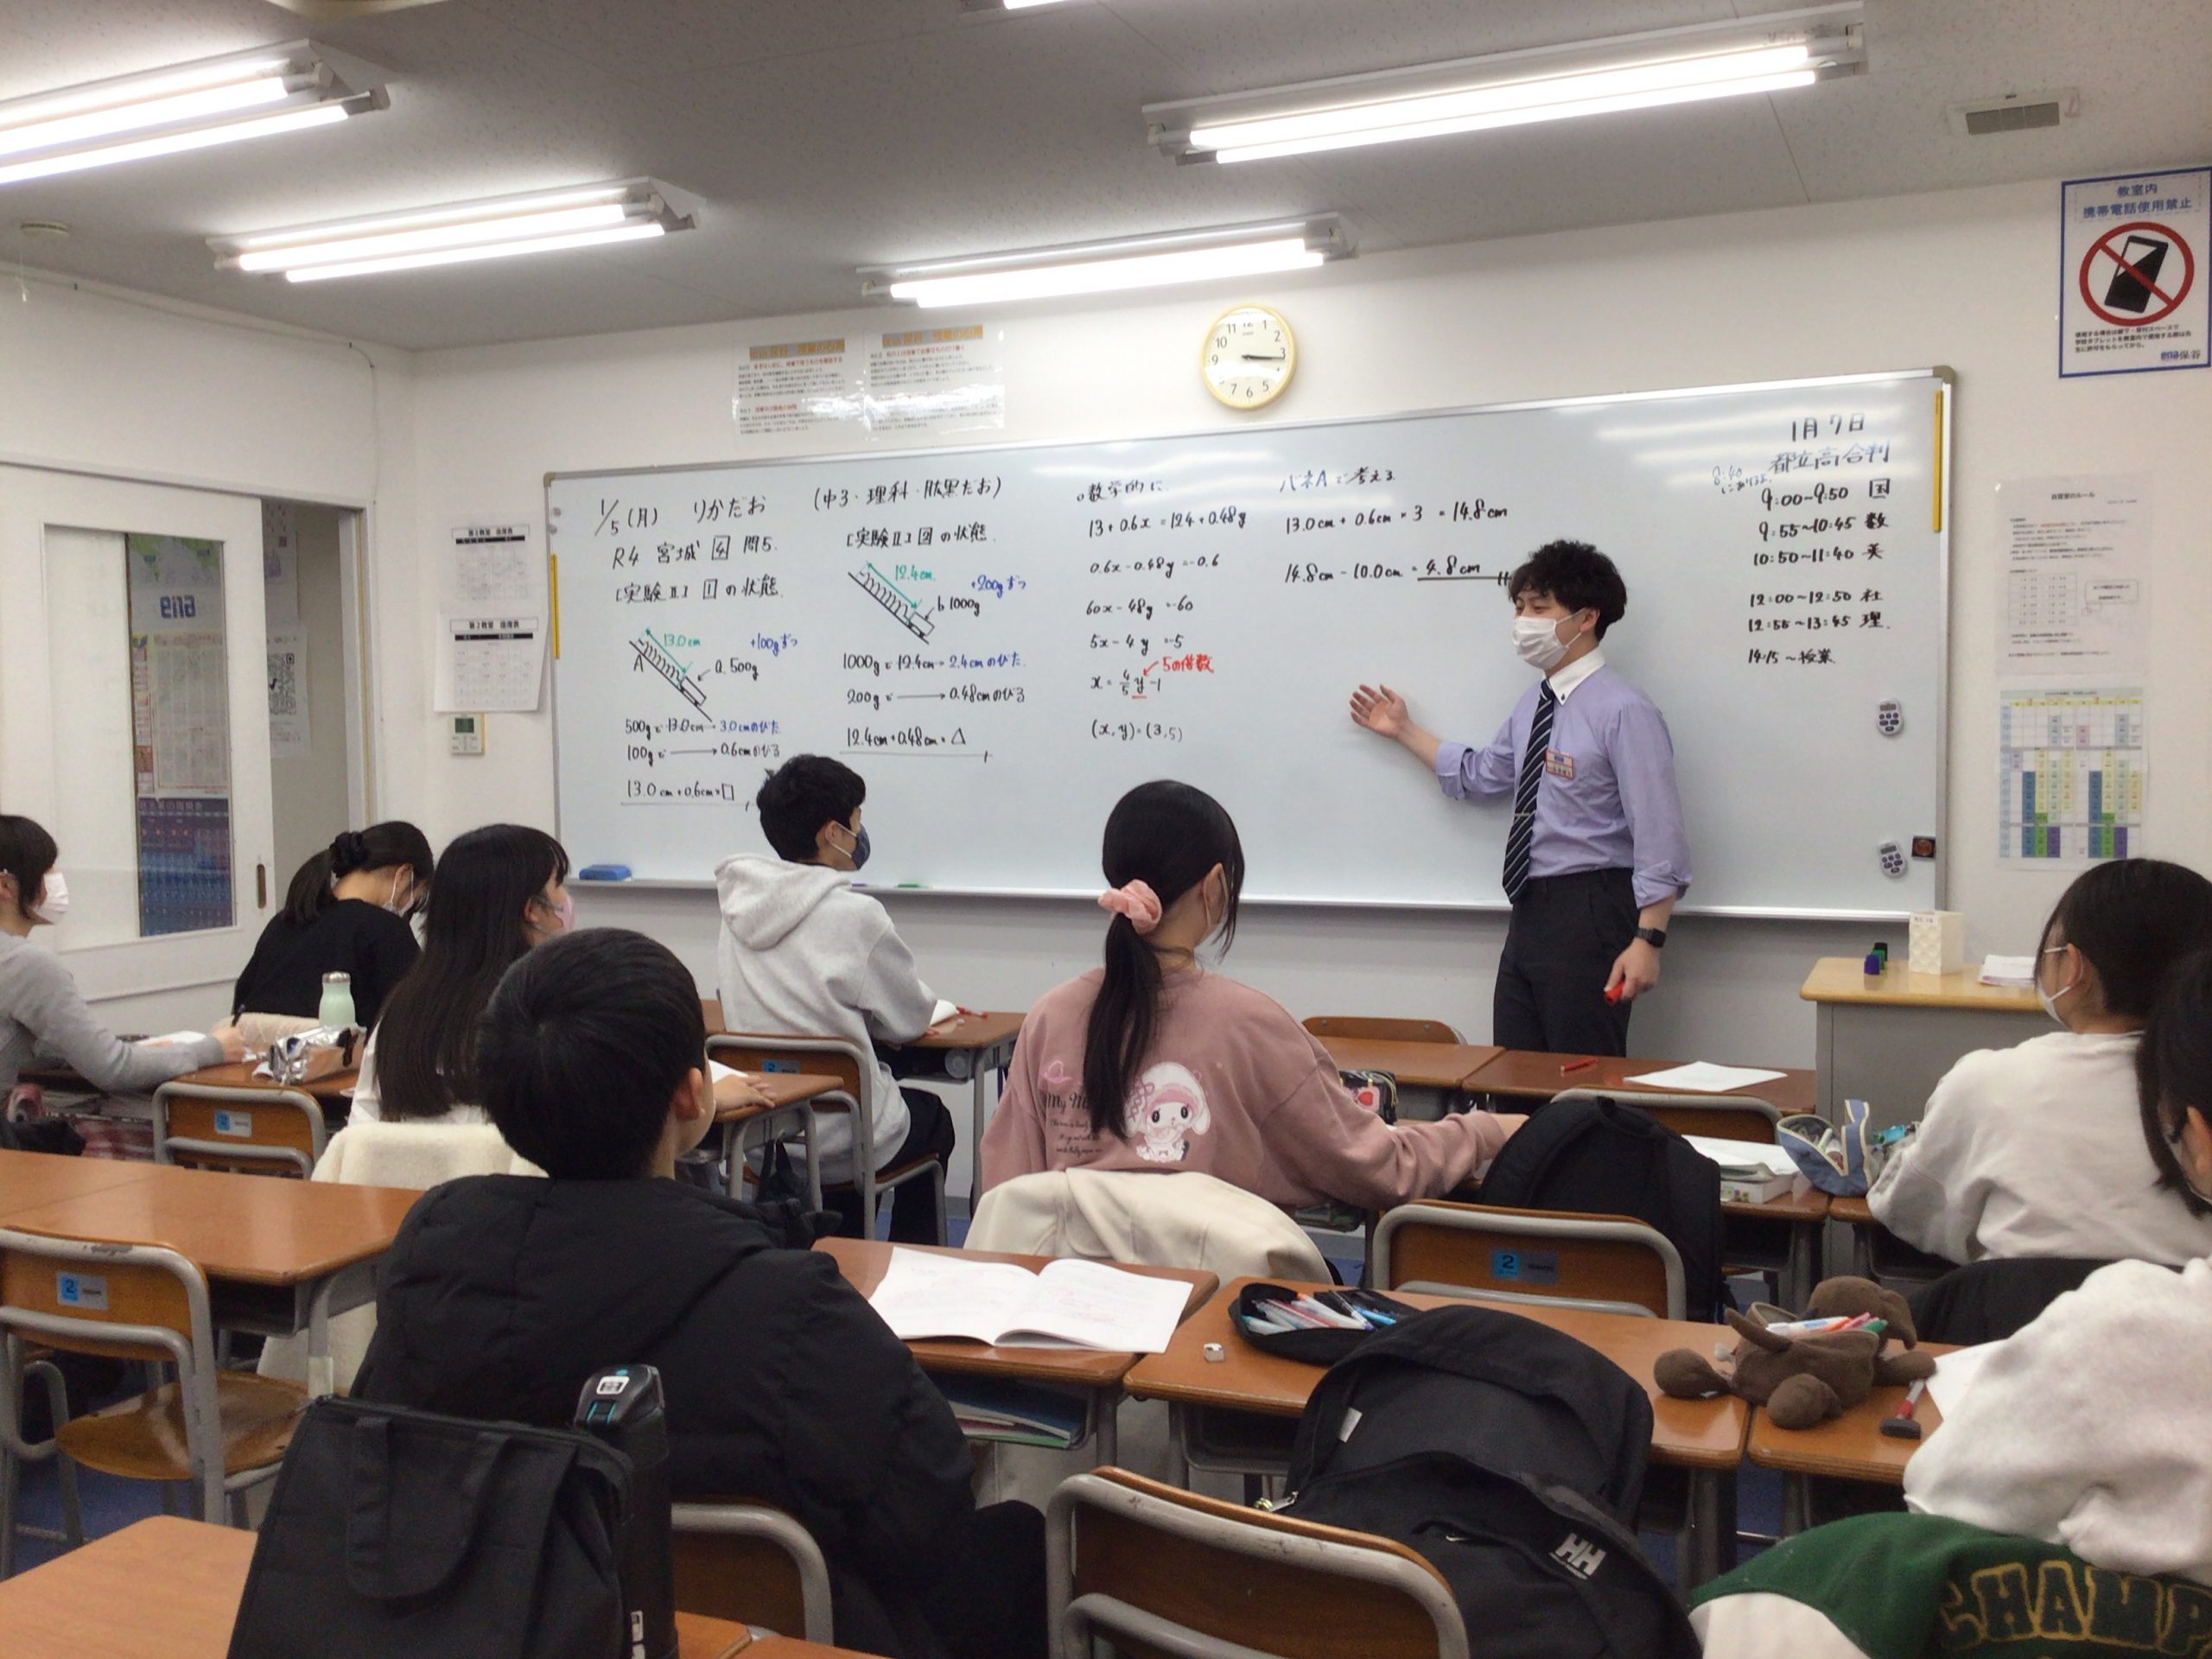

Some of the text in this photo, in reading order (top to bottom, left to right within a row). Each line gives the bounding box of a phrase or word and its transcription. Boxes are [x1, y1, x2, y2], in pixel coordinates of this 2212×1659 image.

[2117, 183, 2158, 198] 教室内
[2083, 197, 2193, 219] 携帯電話使用禁止
[1228, 323, 1236, 334] 11
[1262, 319, 1268, 330] 1
[1216, 335, 1228, 348] 10
[1274, 329, 1281, 342] 2
[1211, 354, 1219, 365] 9
[1280, 346, 1286, 360] 3
[1230, 383, 1237, 395] 7
[1246, 386, 1253, 398] 6
[1262, 380, 1269, 391] 5
[1868, 478, 1891, 499] 国
[1865, 512, 1889, 530] 数
[658, 539, 701, 564] 宮城
[1859, 588, 1884, 603] 社
[950, 596, 981, 617] 1000g
[633, 654, 644, 672] A
[1502, 1255, 1515, 1269] 2
[65, 1278, 76, 1294] 2
